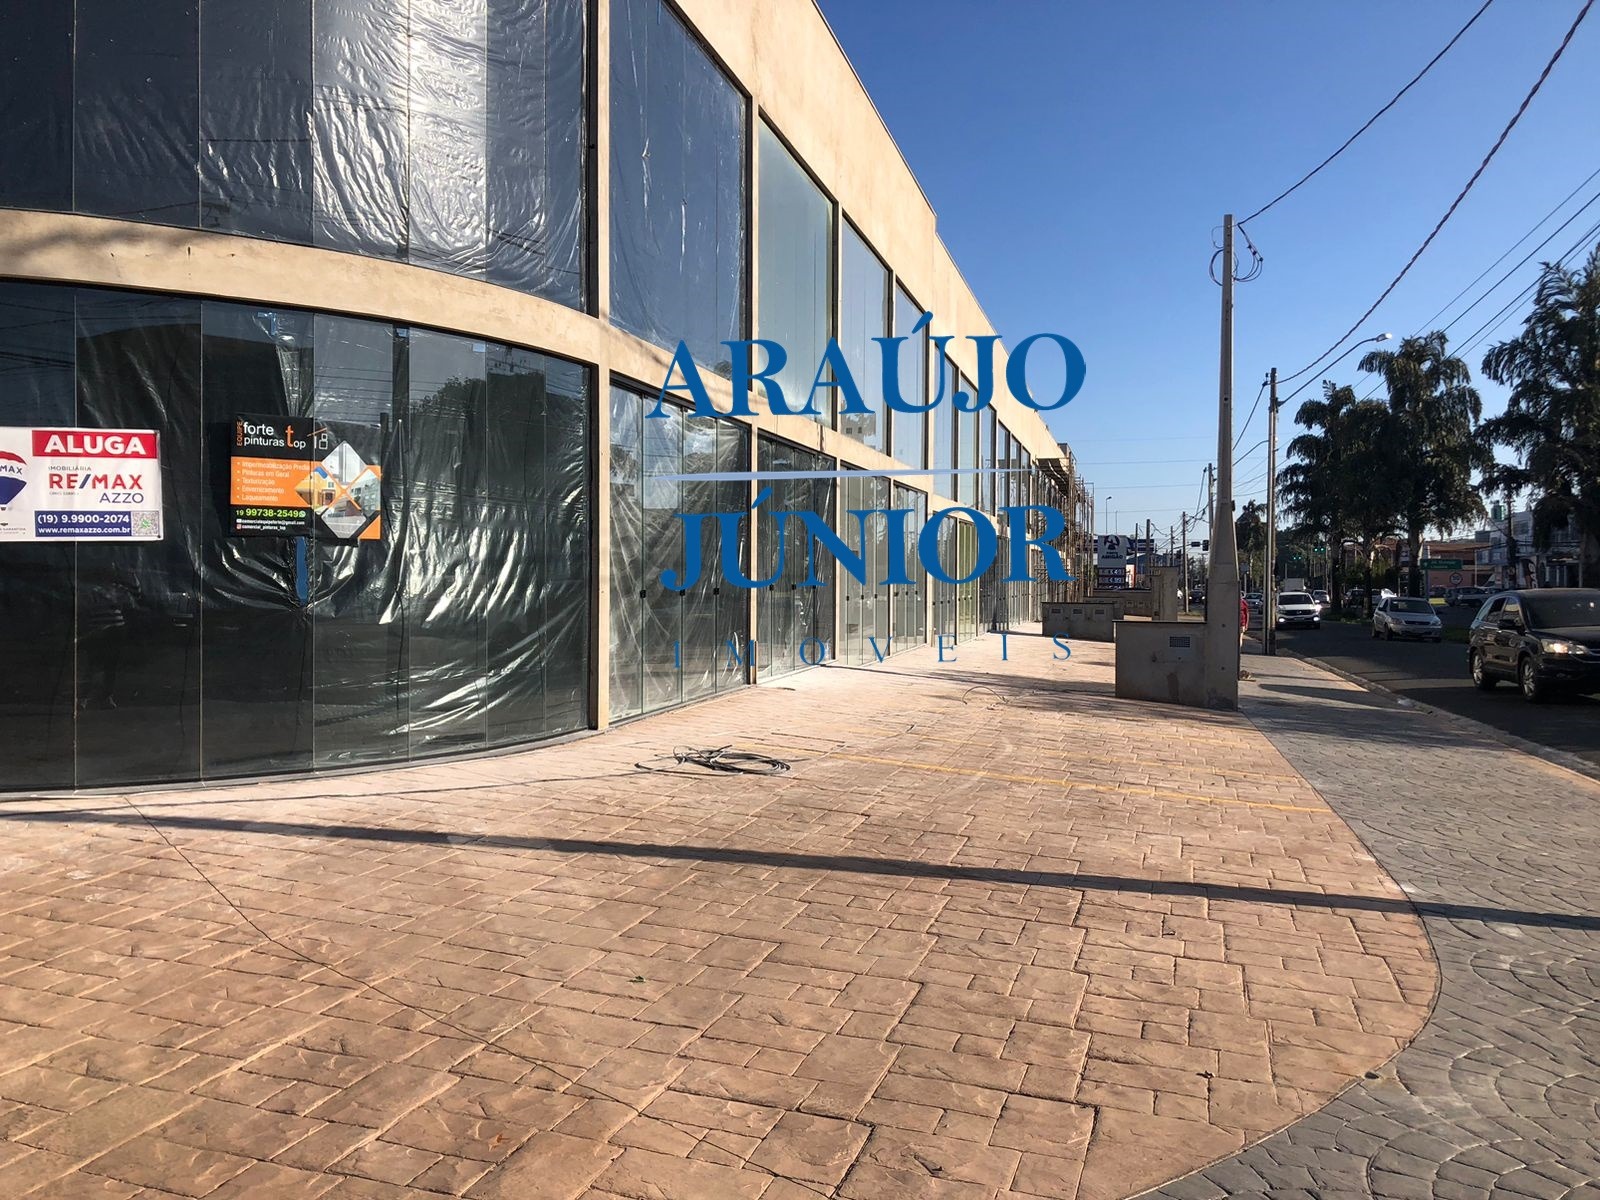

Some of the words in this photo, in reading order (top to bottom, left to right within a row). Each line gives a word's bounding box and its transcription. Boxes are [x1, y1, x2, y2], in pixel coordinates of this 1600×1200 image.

[243, 421, 274, 436] forte
[44, 434, 146, 455] ALUGA
[244, 435, 285, 446] pinturas
[49, 473, 143, 490] RE/MAX
[99, 492, 144, 503] AZZO
[246, 508, 299, 517] 99738-2549
[37, 515, 58, 525] (19)
[61, 514, 130, 524] 9.9900-2074
[38, 526, 130, 534] www.remaxazzo.com.br
